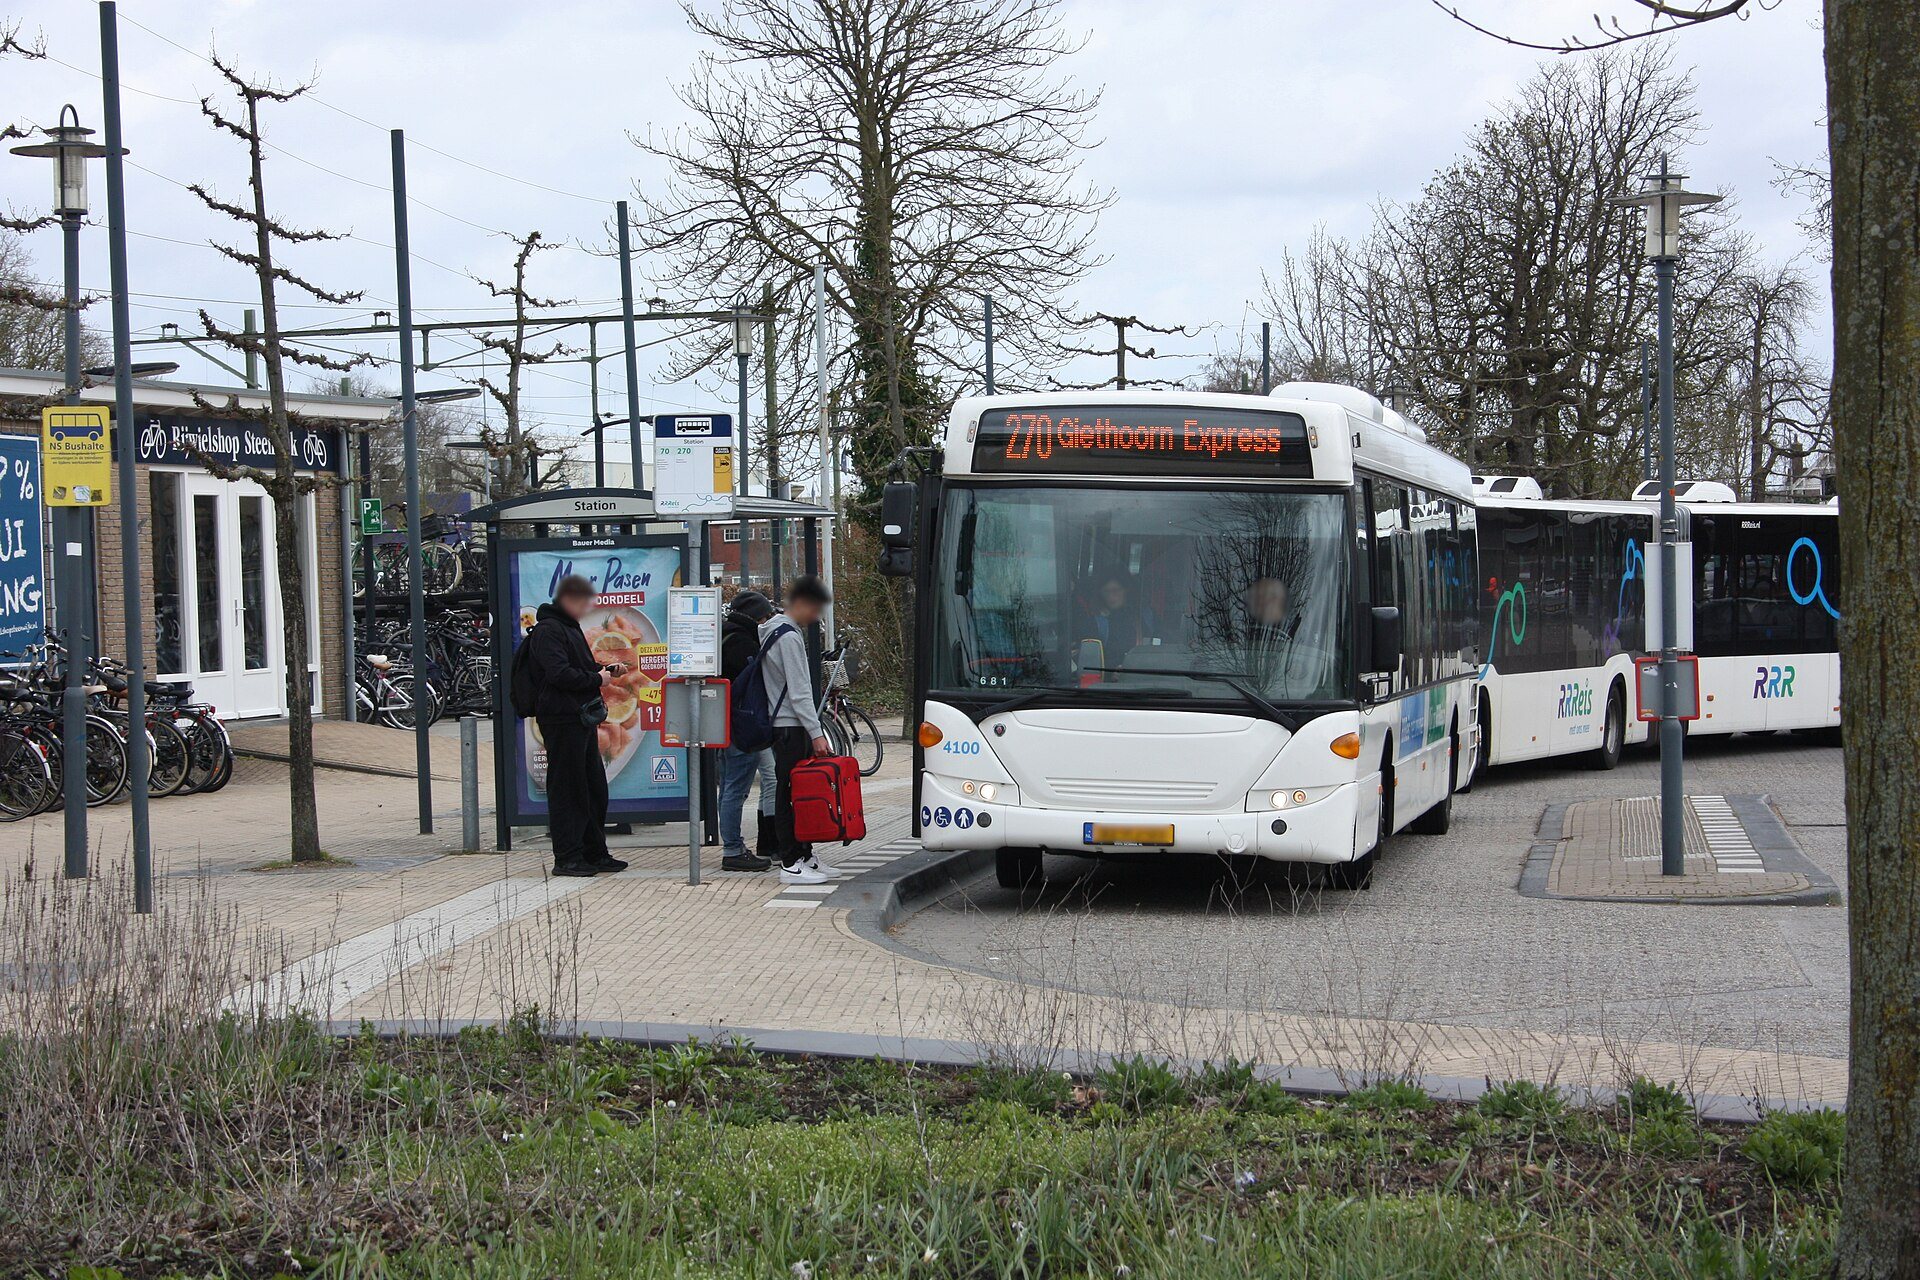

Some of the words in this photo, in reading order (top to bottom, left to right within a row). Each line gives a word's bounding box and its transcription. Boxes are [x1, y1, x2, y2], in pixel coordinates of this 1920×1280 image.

[1006, 414, 1051, 459] 270
[1058, 417, 1173, 450] Giethoorn
[1184, 419, 1280, 458] Express
[50, 442, 62, 451] NS
[65, 442, 104, 451] Bushalte
[363, 501, 371, 514] P
[574, 501, 616, 511] Station
[602, 557, 651, 594] Pasen
[640, 646, 653, 654] DEZE
[1754, 666, 1795, 698] RRR
[1558, 679, 1592, 718] RRReis
[943, 741, 980, 755] 4100
